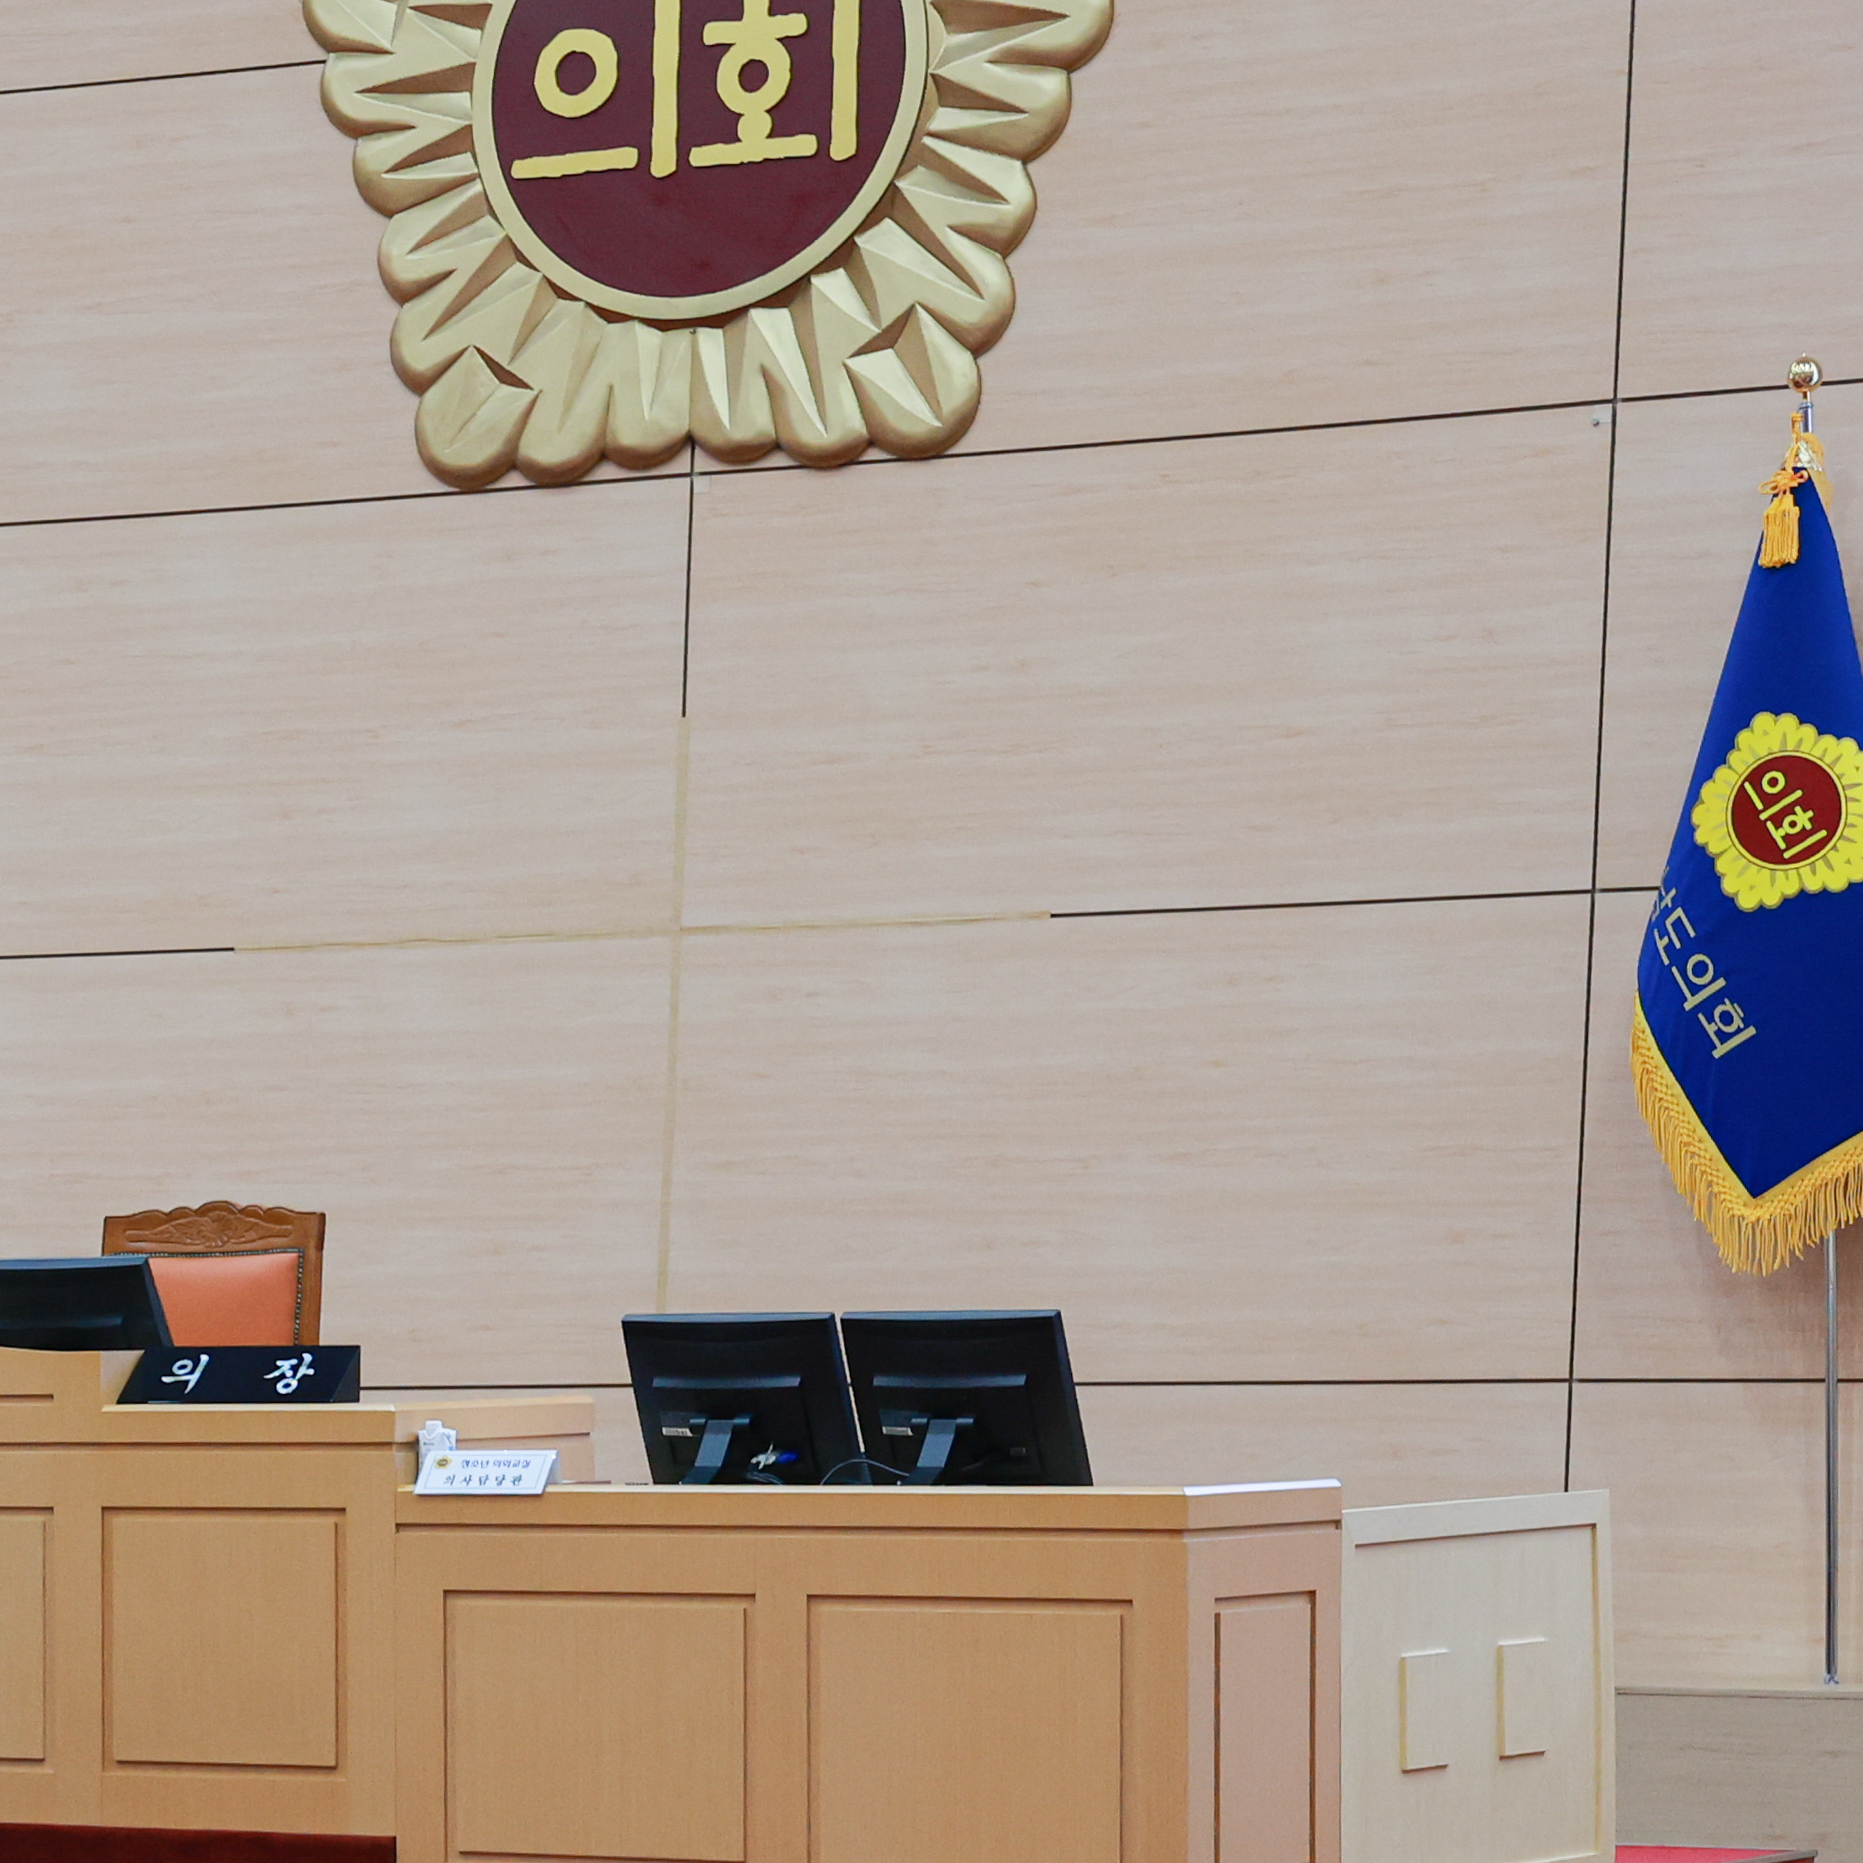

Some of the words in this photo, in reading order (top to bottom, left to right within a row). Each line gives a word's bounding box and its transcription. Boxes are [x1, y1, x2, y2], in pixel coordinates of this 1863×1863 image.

[510, 0, 859, 178] 의회
[1743, 770, 1828, 860] 의회
[1651, 866, 1757, 1060] 도의회
[160, 1352, 316, 1395] 의장
